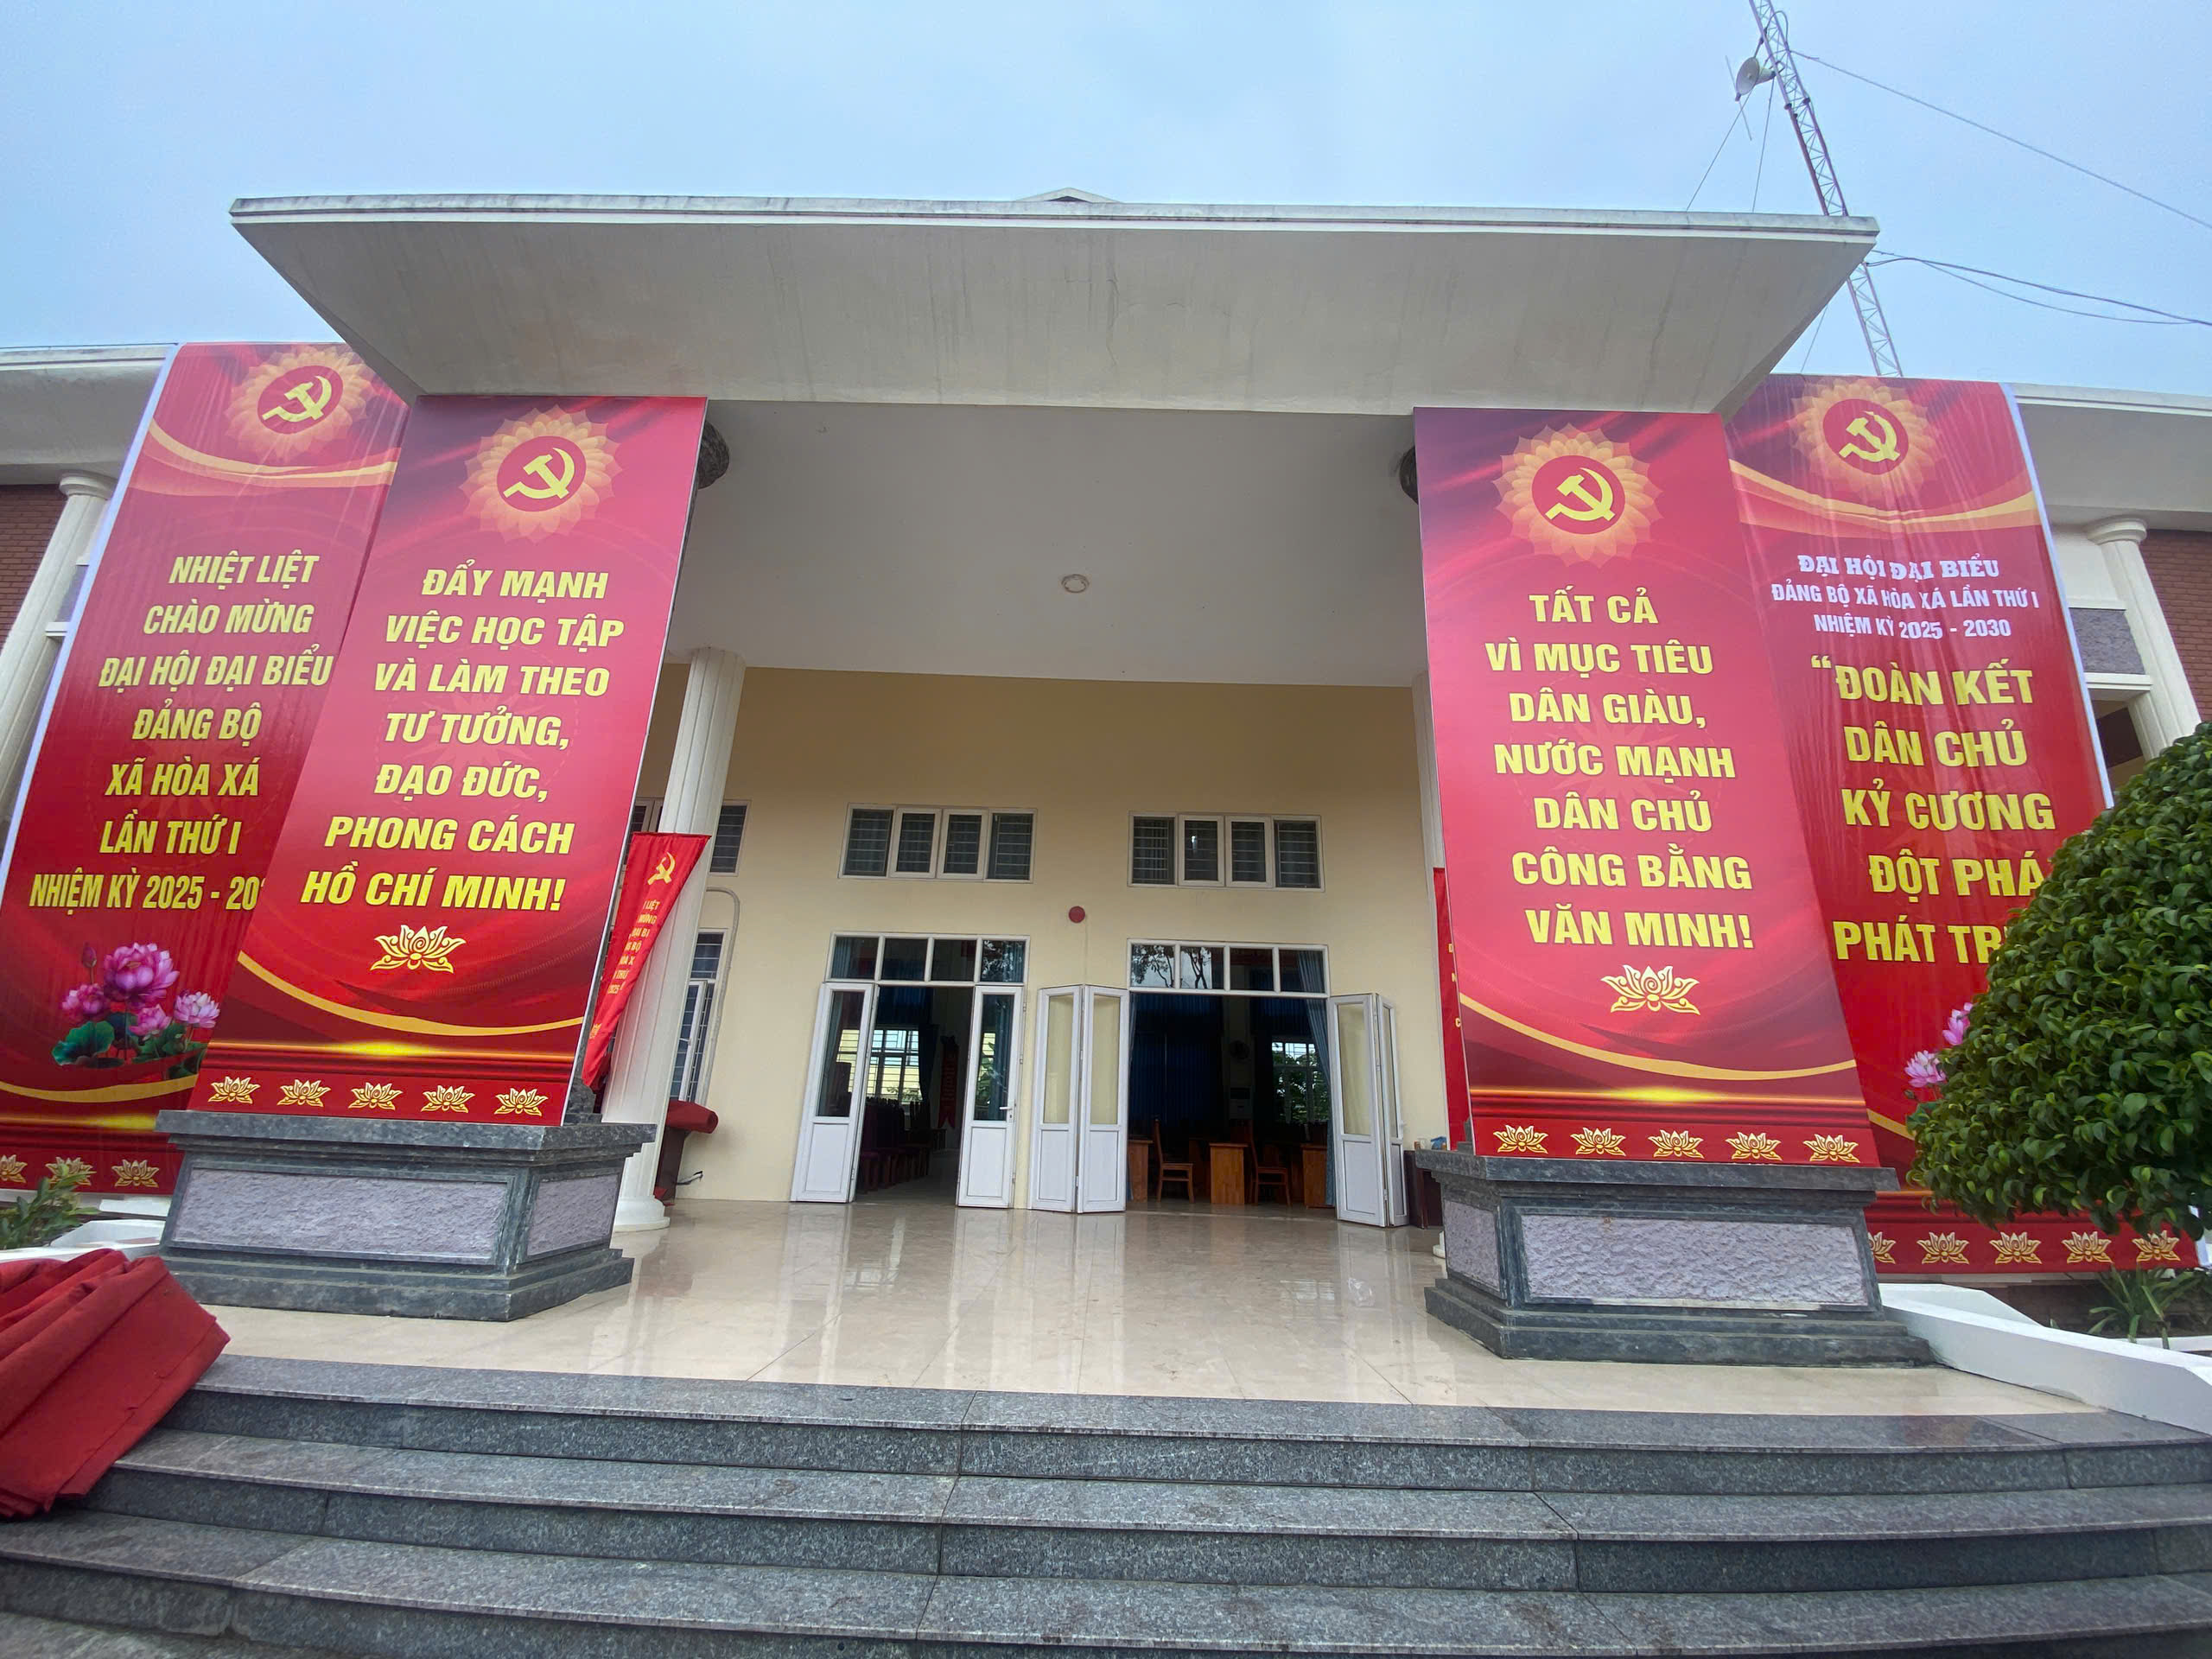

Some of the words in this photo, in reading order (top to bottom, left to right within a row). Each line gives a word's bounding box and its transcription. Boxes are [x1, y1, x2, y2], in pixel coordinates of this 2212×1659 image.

[168, 550, 256, 590] NHIỆT
[256, 549, 320, 589] LIỆT
[421, 558, 493, 596] ĐẨY
[499, 570, 609, 604] MẠNH
[1796, 555, 1840, 577] ĐẠI
[1843, 554, 1886, 581] HỘI
[1888, 561, 1935, 583] ĐẠI
[1940, 552, 1999, 578] BIỂU
[143, 598, 220, 634] CHÀO
[224, 598, 315, 633] MỪNG
[1529, 585, 1594, 623] TẤT
[1606, 587, 1659, 624] CẢ
[1770, 578, 1823, 602] ĐẢNG
[1826, 583, 1850, 608] BỘ
[1853, 584, 1879, 606] XÃ
[1880, 588, 1916, 610] HÒA
[1918, 587, 1947, 610] XÁ
[1949, 583, 1990, 607] LẦN
[1992, 587, 2029, 608] THỨ
[2031, 591, 2040, 608] I
[385, 609, 463, 649] VIỆC
[471, 616, 545, 651] HỌC
[557, 613, 625, 653] TẬP
[1813, 612, 1872, 638] NHIỆM
[1875, 615, 1895, 637] KỲ
[1898, 620, 1943, 639] 2025
[1962, 619, 2012, 637] 2030
[98, 656, 147, 694] ĐẠI
[149, 649, 201, 692] HỘI
[204, 655, 257, 692] ĐẠI
[261, 643, 334, 686] BIỂU
[374, 657, 416, 691] VÀ
[427, 658, 509, 693] LÀM
[520, 665, 610, 696] THEO
[1484, 637, 1522, 671] VÌ
[1534, 643, 1620, 678] MỤC
[1630, 639, 1713, 674] TIÊU
[1810, 655, 1944, 706] “ĐOÀN
[1952, 658, 2033, 705] KẾT
[131, 697, 214, 740] ĐẢNG
[218, 702, 263, 747] BỘ
[385, 710, 435, 742] TƯ
[440, 705, 569, 750] TƯỞNG,
[1509, 687, 1591, 722] DÂN
[1602, 688, 1706, 728] GIÀU,
[1494, 738, 1604, 775] NƯỚC
[1615, 746, 1736, 784] MẠNH
[1843, 720, 1924, 766] DÂN
[1934, 718, 2027, 767] CHỦ
[105, 757, 146, 796] XÃ
[149, 755, 210, 796] HÒA
[217, 757, 261, 796] XÁ
[373, 764, 453, 802] ĐẠO
[461, 760, 548, 803] ĐỨC,
[1534, 791, 1619, 830] DÂN
[1630, 790, 1712, 832] CHỦ
[1840, 778, 1891, 827] KỶ
[1904, 790, 2056, 831] CƯƠNG
[99, 809, 159, 854] LẦN
[165, 813, 228, 855] THỨ
[227, 821, 242, 855] I
[324, 816, 458, 850] PHONG
[467, 814, 575, 855] CÁCH
[300, 861, 359, 905] HỒ
[365, 867, 437, 906] CHÍ
[441, 874, 566, 912] MINH!
[1512, 845, 1626, 887] CÔNG
[1637, 842, 1752, 890] BẰNG
[1868, 848, 1940, 903] ĐỘT
[1951, 850, 2047, 899] PHÁ
[29, 867, 105, 915] NHIỆM
[106, 867, 141, 908] KỲ
[142, 874, 206, 910] 2025
[225, 876, 266, 911] 20
[1524, 903, 1613, 945] VĂN
[1624, 912, 1753, 949] MINH!
[1832, 914, 1936, 963] PHÁT
[1947, 925, 2009, 963] TR
